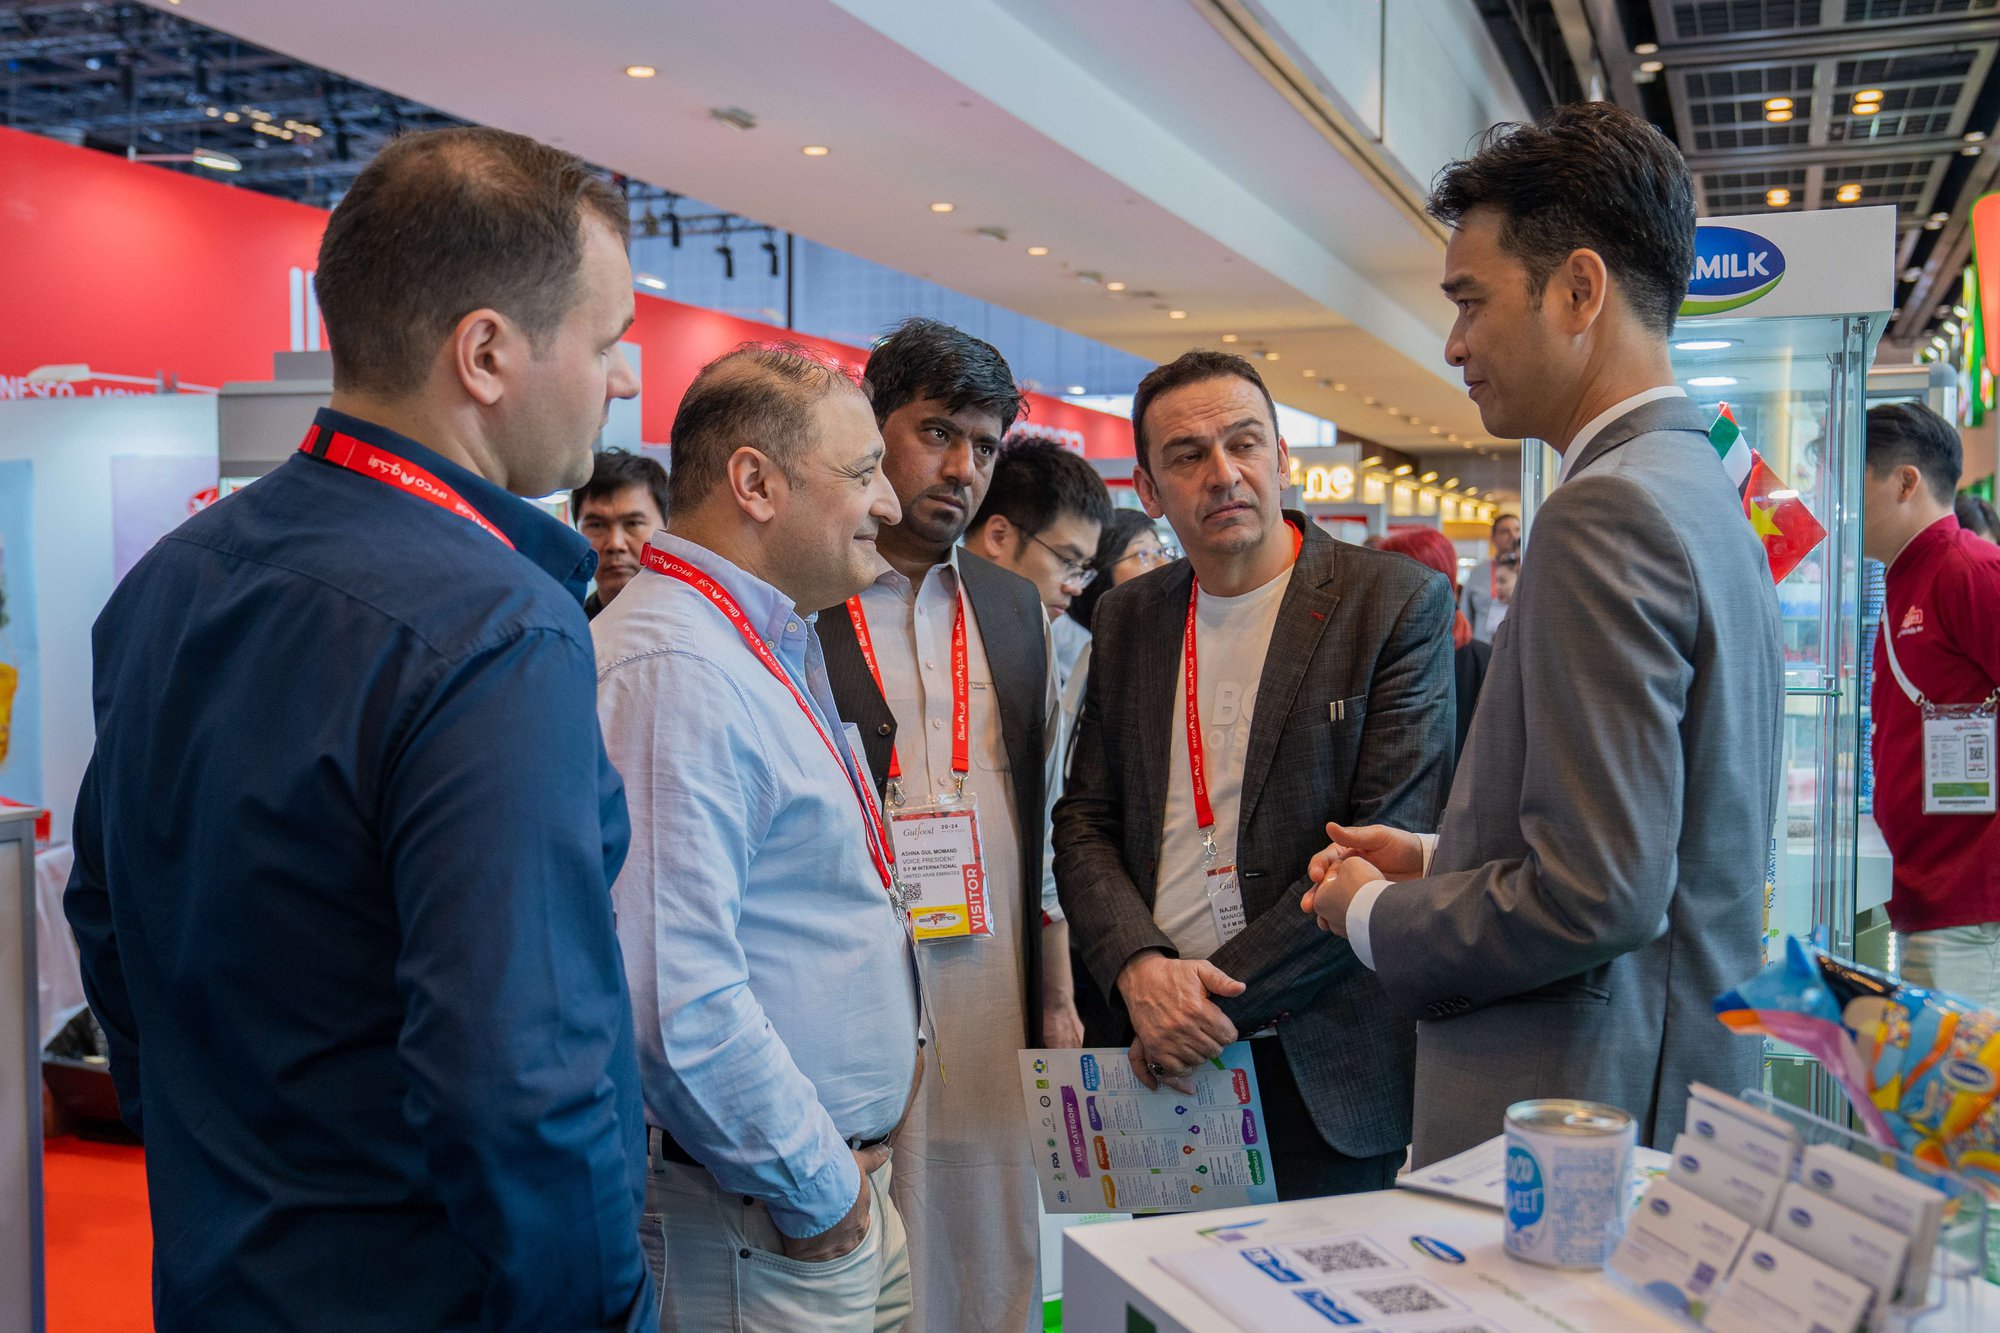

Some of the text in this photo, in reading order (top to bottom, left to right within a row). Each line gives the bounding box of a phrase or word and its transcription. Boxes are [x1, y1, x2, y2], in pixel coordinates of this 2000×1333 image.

[1690, 251, 1770, 281] MILK
[415, 478, 448, 499] IFFCO
[672, 564, 693, 578] IFFCO
[903, 822, 934, 840] Gulfood
[966, 868, 984, 930] VISITOR
[1219, 904, 1238, 913] NAJIB
[1238, 1072, 1247, 1100] PROBIOTIC
[1067, 1102, 1083, 1162] SUB CATEGORY
[1246, 1116, 1254, 1137] YOGURT
[1052, 1152, 1060, 1168] FDA
[1096, 1142, 1104, 1164] POWDER
[1252, 1150, 1261, 1184] CONDENSATE
[1104, 1181, 1112, 1202] POWDER
